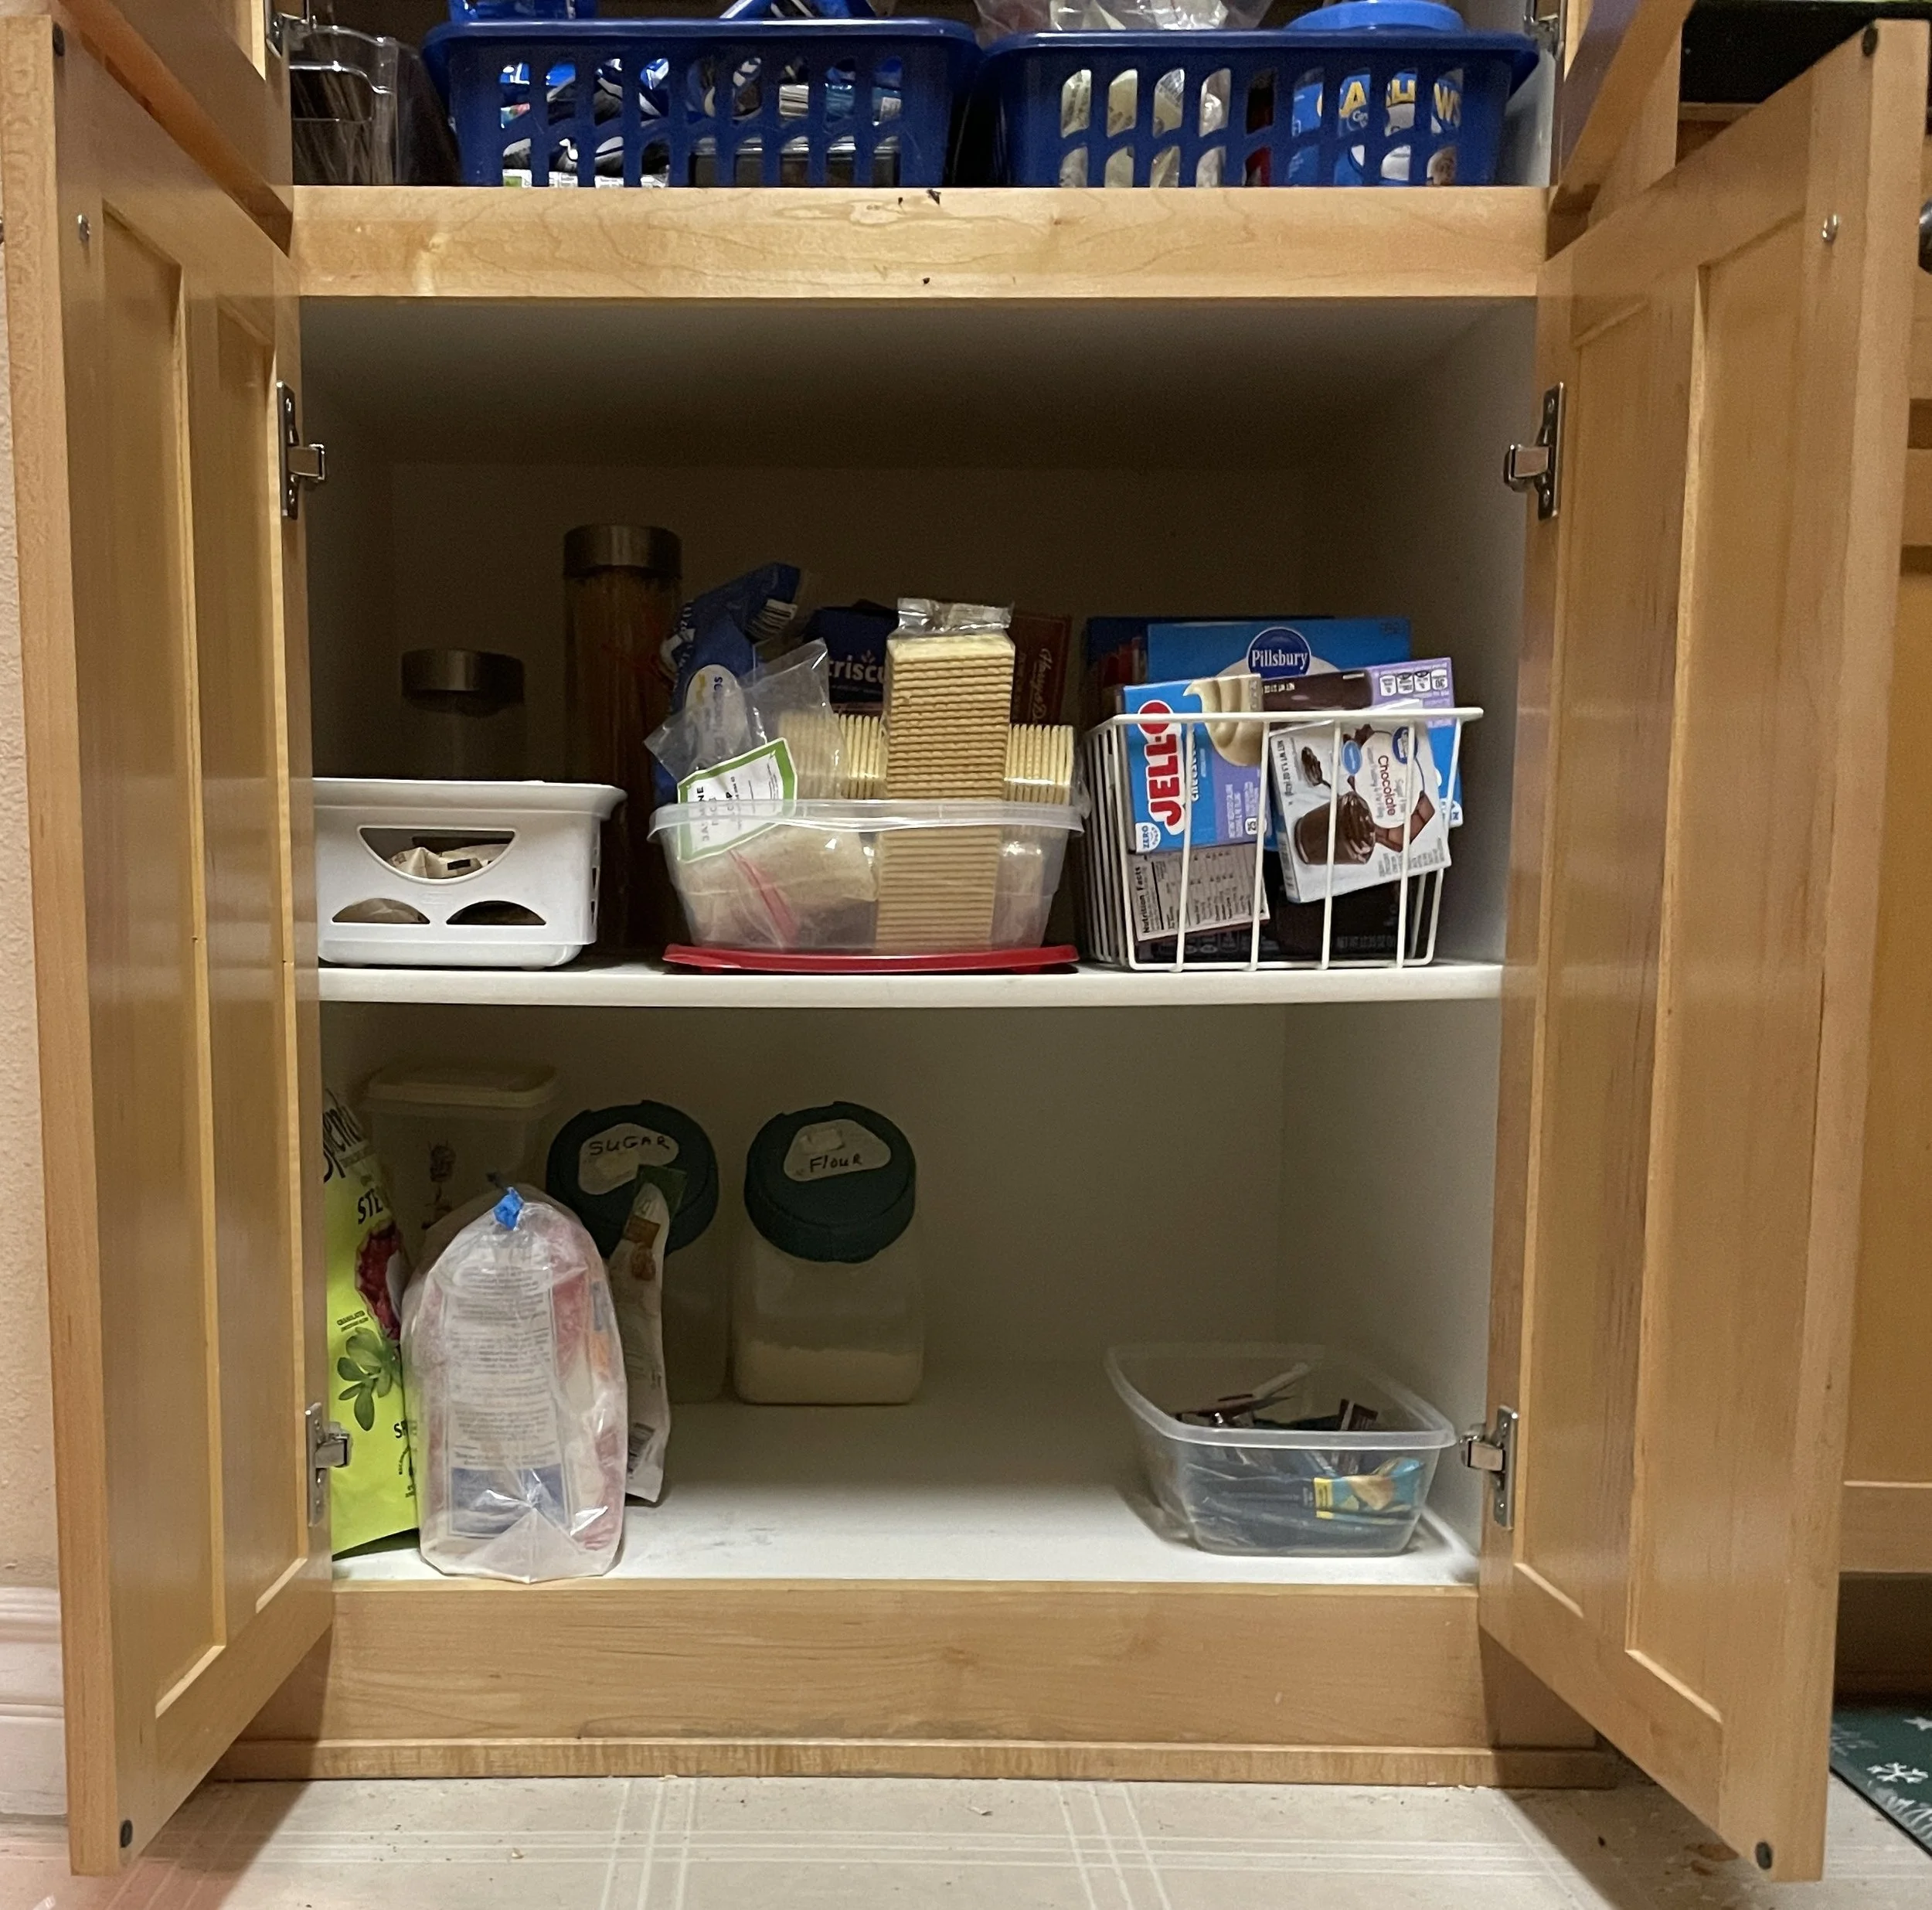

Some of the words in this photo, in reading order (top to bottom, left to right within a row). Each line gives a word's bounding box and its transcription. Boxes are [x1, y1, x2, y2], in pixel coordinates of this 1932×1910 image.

[1251, 649, 1308, 670] Pillsbury
[1378, 754, 1396, 816] Chocolate
[1141, 825, 1150, 849] ZERO
[1134, 866, 1144, 890] Facts
[1139, 894, 1151, 933] Nutrition
[589, 1135, 670, 1156] SUGAR
